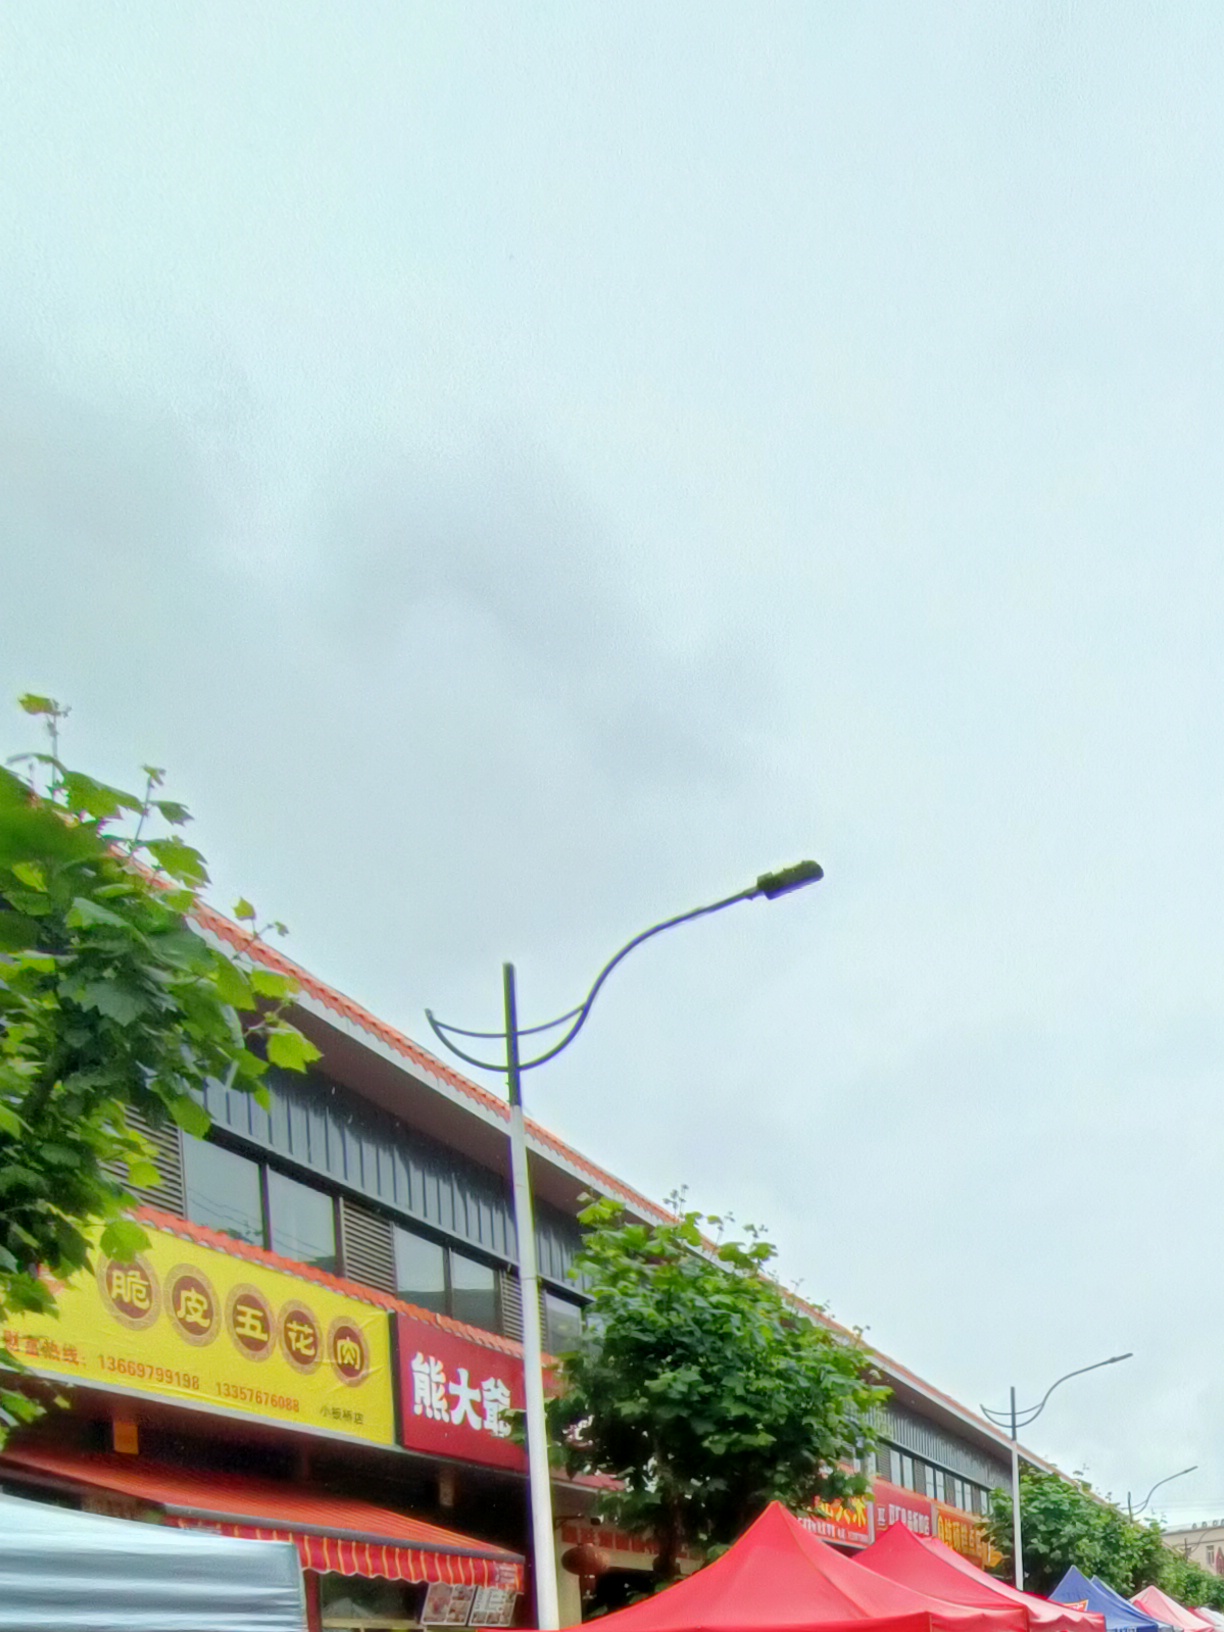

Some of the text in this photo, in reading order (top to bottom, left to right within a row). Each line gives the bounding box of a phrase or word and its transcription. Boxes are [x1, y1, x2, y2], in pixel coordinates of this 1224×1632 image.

[109, 1266, 364, 1373] 脆皮五花肉
[97, 1353, 200, 1390] 13669799198
[215, 1381, 300, 1413] 13357676088
